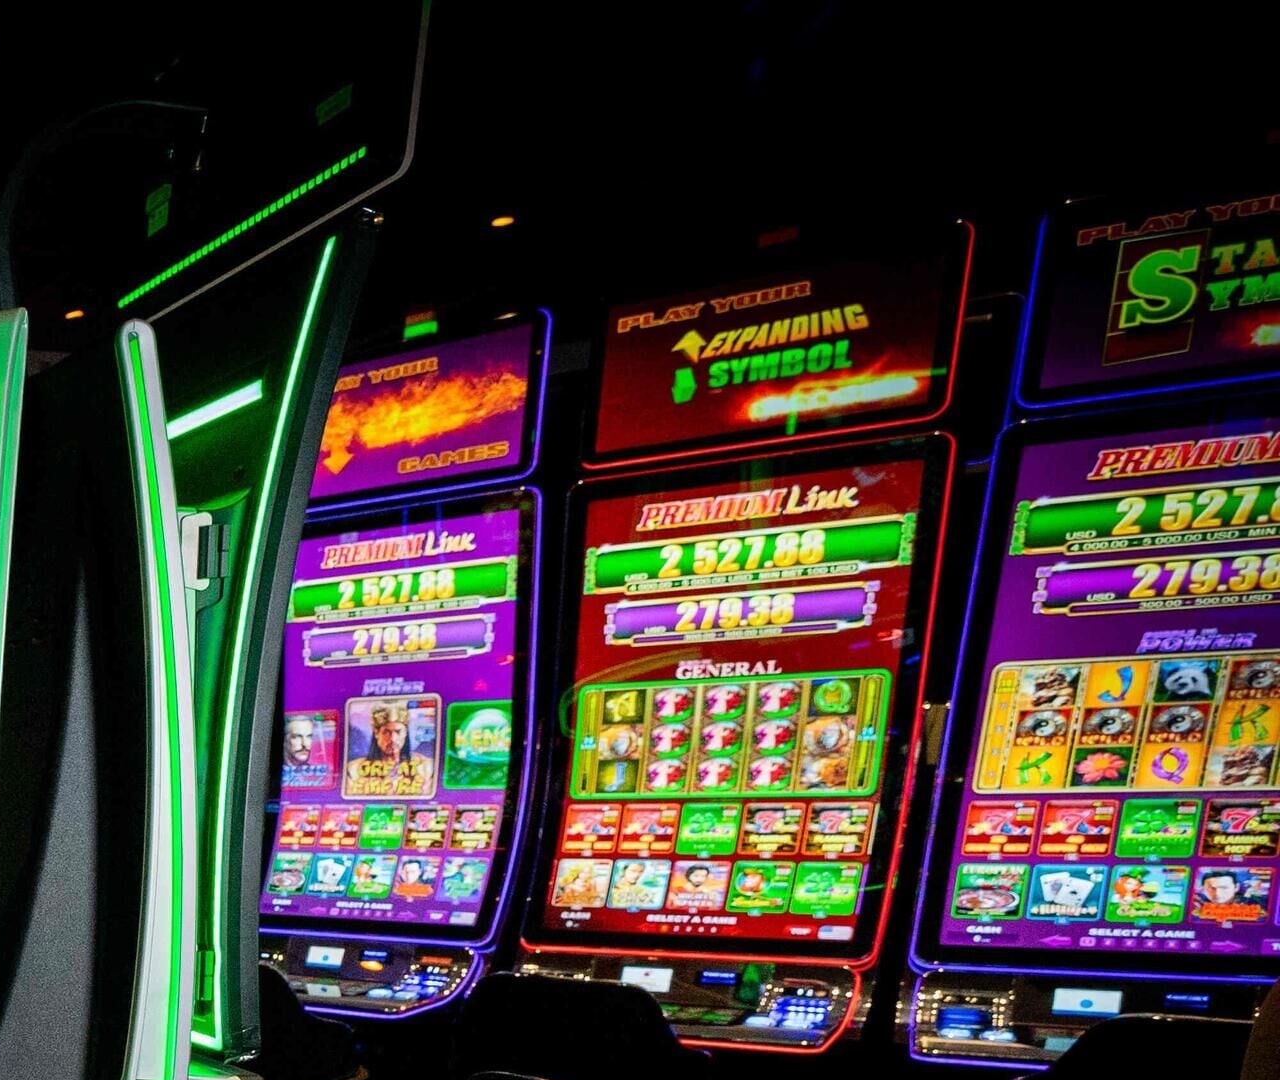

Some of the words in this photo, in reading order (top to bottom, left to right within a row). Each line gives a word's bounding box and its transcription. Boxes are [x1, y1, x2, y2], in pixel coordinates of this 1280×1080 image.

[1077, 209, 1197, 247] PLAY
[617, 302, 705, 333] PLAY
[710, 281, 811, 314] YOUR
[700, 303, 869, 359] EXPANDING
[368, 356, 439, 384] YOUR
[708, 339, 853, 389] SYMBOL
[397, 441, 510, 474] GAMES
[636, 488, 788, 531] PREMIUM
[320, 533, 426, 569] PREMIUM
[1065, 530, 1097, 541] USD
[1070, 543, 1080, 552] 4
[1082, 540, 1129, 551] 000.00
[1154, 534, 1202, 545] 000.00
[1206, 530, 1239, 542] USD
[1247, 526, 1276, 537] MIN
[675, 593, 796, 632] 279.38
[1086, 592, 1116, 602] USD
[1241, 593, 1273, 604] USD
[352, 622, 437, 656] 279.38
[675, 659, 782, 680] GENERAL
[966, 925, 1002, 934] CASH
[1088, 928, 1134, 938] SELECT
[1140, 929, 1152, 937] A
[1153, 929, 1196, 940] GAME
